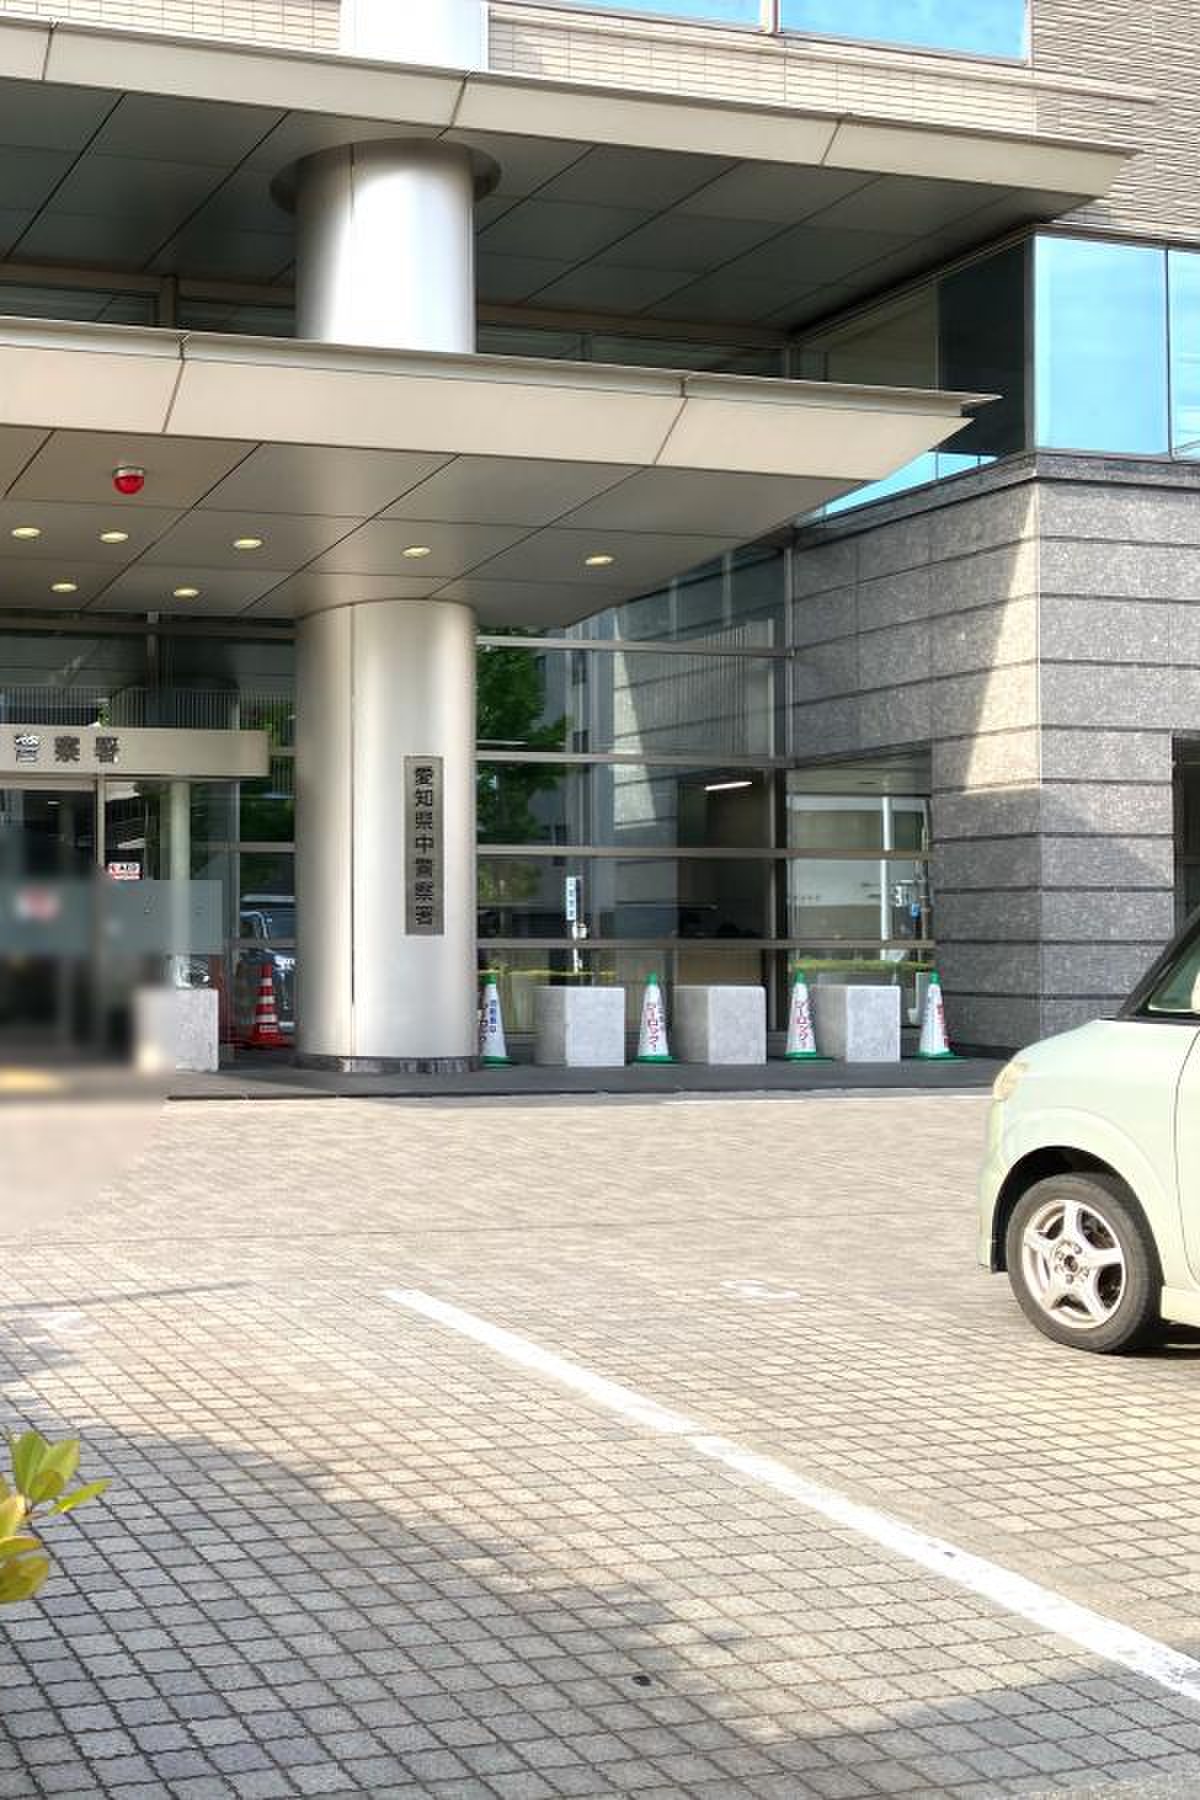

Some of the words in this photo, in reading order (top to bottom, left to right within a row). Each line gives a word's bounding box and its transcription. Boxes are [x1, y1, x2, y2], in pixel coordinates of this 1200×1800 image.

[413, 766, 434, 926] 愛知県中警察署
